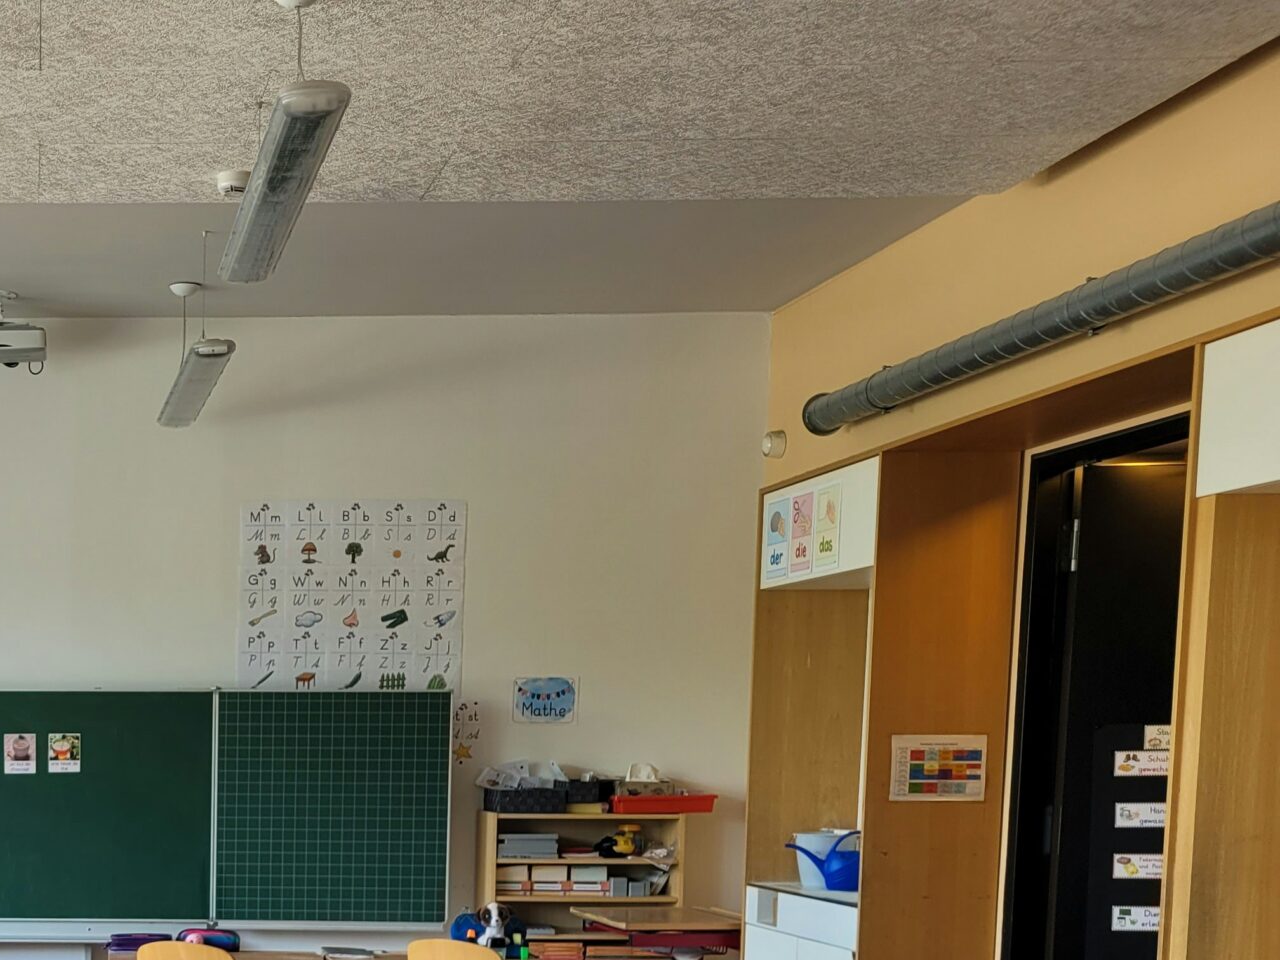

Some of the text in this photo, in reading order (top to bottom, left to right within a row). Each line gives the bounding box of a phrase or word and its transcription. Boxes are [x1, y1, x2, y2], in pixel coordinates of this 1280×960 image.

[250, 512, 260, 522] M
[298, 510, 304, 522] L
[343, 511, 349, 521] B
[363, 511, 369, 521] b
[385, 511, 393, 522] S
[428, 510, 436, 521] D
[449, 511, 455, 522] d
[770, 536, 833, 565] der die das
[248, 575, 258, 585] G
[270, 579, 276, 590] g
[293, 575, 307, 587] W
[339, 576, 347, 587] N
[382, 576, 390, 588] H
[404, 577, 409, 587] h
[427, 576, 433, 587] R
[248, 637, 255, 648] P
[268, 641, 275, 653] p
[293, 639, 301, 650] T
[314, 639, 319, 650] t
[338, 637, 344, 648] F
[359, 637, 364, 648] f
[380, 639, 388, 650] Z
[425, 639, 432, 650] J
[522, 702, 566, 717] Mathe
